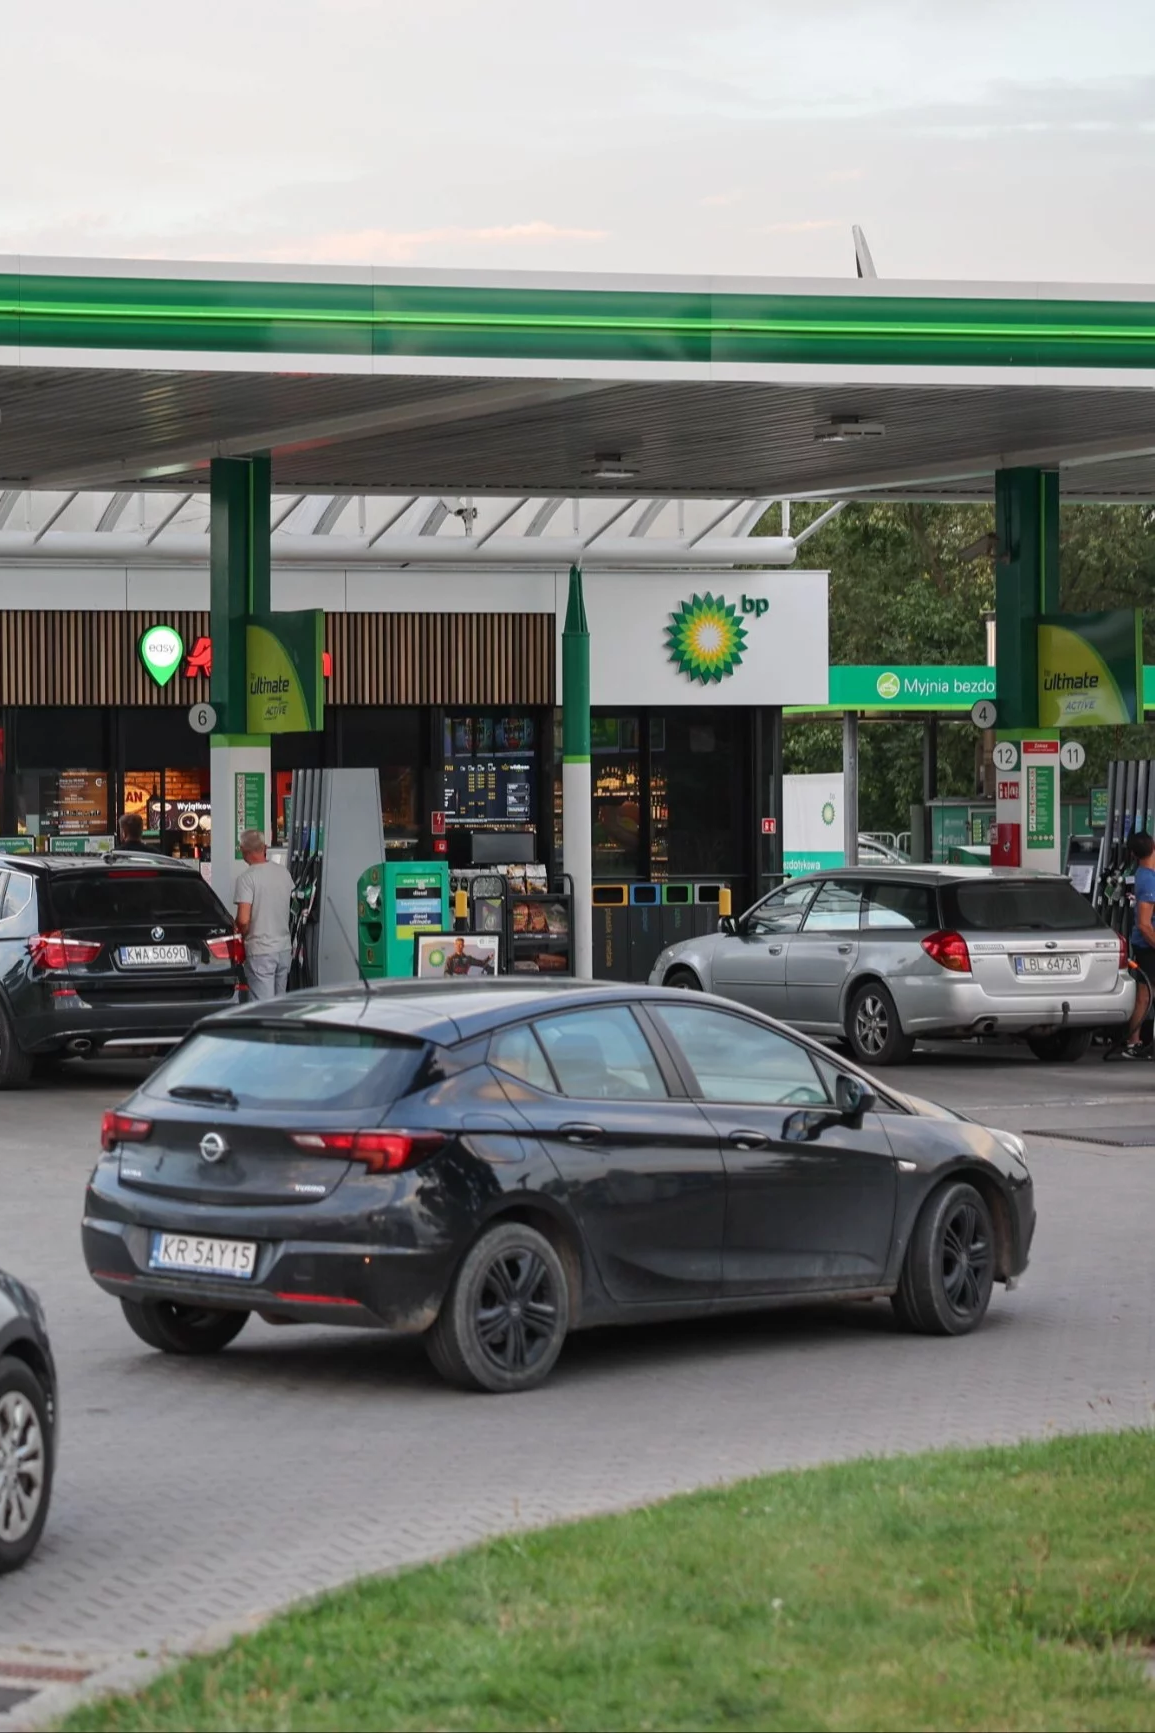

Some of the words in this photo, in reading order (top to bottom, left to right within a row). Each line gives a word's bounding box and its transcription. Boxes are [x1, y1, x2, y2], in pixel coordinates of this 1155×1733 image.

[741, 594, 769, 618] bp
[148, 641, 175, 654] easy
[250, 676, 290, 695] ultimate
[904, 679, 949, 696] Myjnia
[954, 679, 995, 693] bezdo
[1044, 671, 1099, 691] ultimate
[979, 707, 987, 721] 4
[1065, 701, 1095, 711] ACTIVE
[198, 710, 207, 727] 6
[997, 748, 1013, 764] 12
[1067, 748, 1079, 764] 11
[126, 791, 143, 802] AN
[177, 802, 211, 812] Wyjątkow
[127, 948, 149, 960] KWA
[153, 946, 186, 960] 50690
[1023, 958, 1043, 971] LBL
[1047, 957, 1078, 972] 64734
[161, 1238, 188, 1263] KR
[194, 1240, 250, 1269] 5AY15
